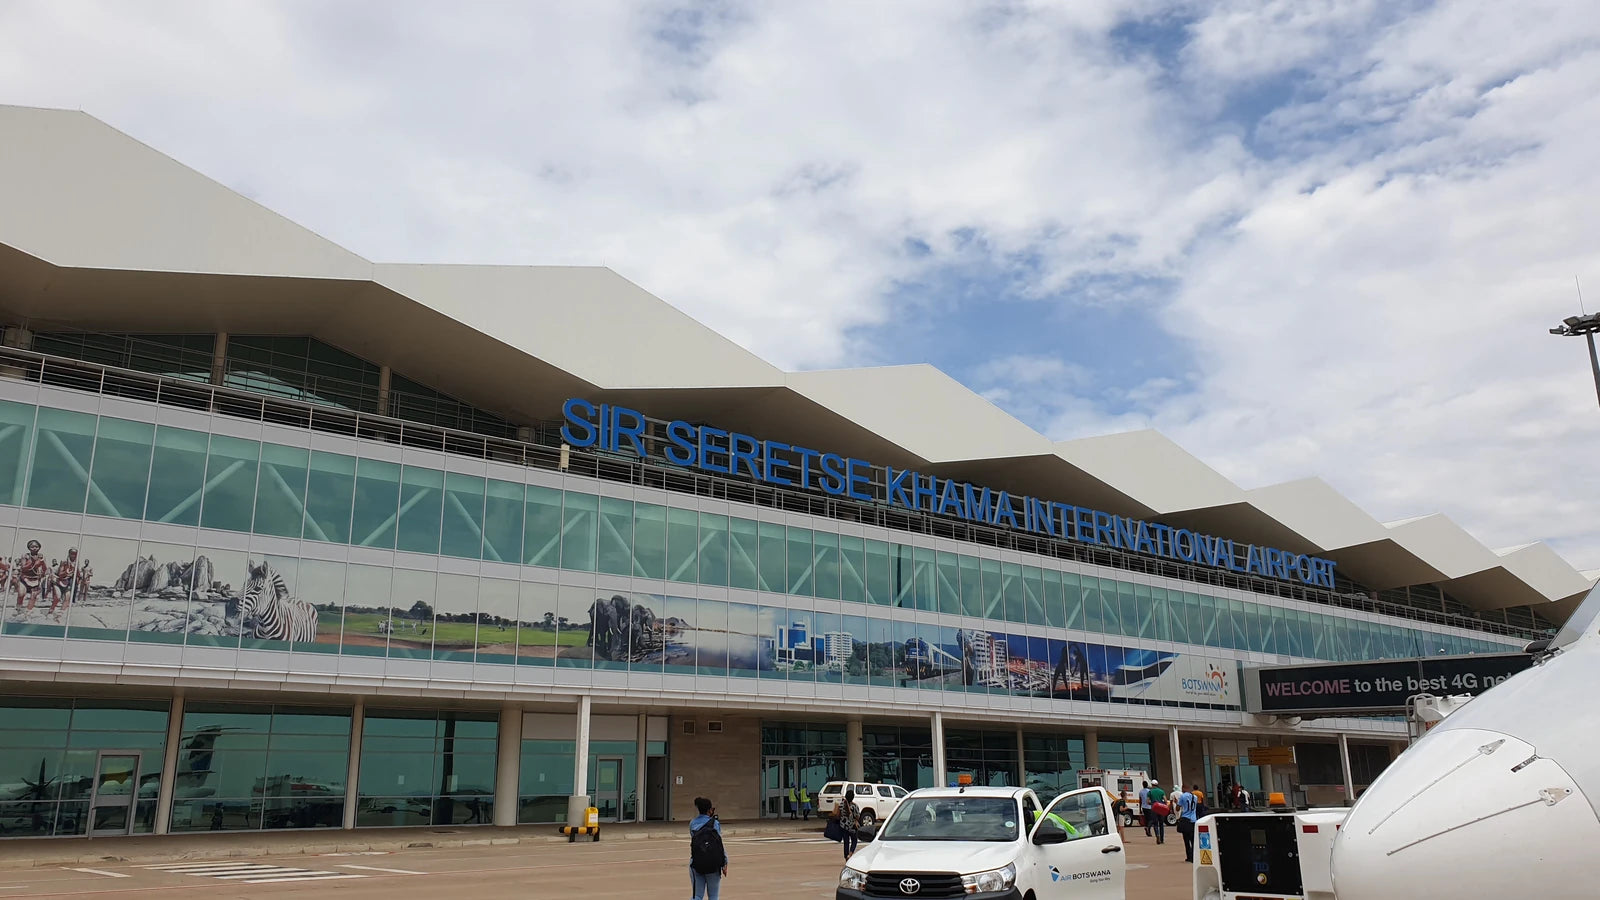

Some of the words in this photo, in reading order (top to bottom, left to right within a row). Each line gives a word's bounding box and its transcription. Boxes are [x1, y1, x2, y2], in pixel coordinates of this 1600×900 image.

[561, 398, 648, 457] SIR
[664, 420, 873, 501] SERETSE
[886, 466, 1018, 529] KHAMA
[1023, 495, 1245, 572] INTERNATIONAL
[1246, 543, 1337, 588] AIRPORT
[1265, 679, 1350, 697] WELCOME
[1354, 679, 1372, 693] to
[1375, 675, 1403, 692] the
[1406, 675, 1448, 691] best
[1451, 672, 1478, 689] 4G
[1072, 869, 1111, 880] BOTSWANA
